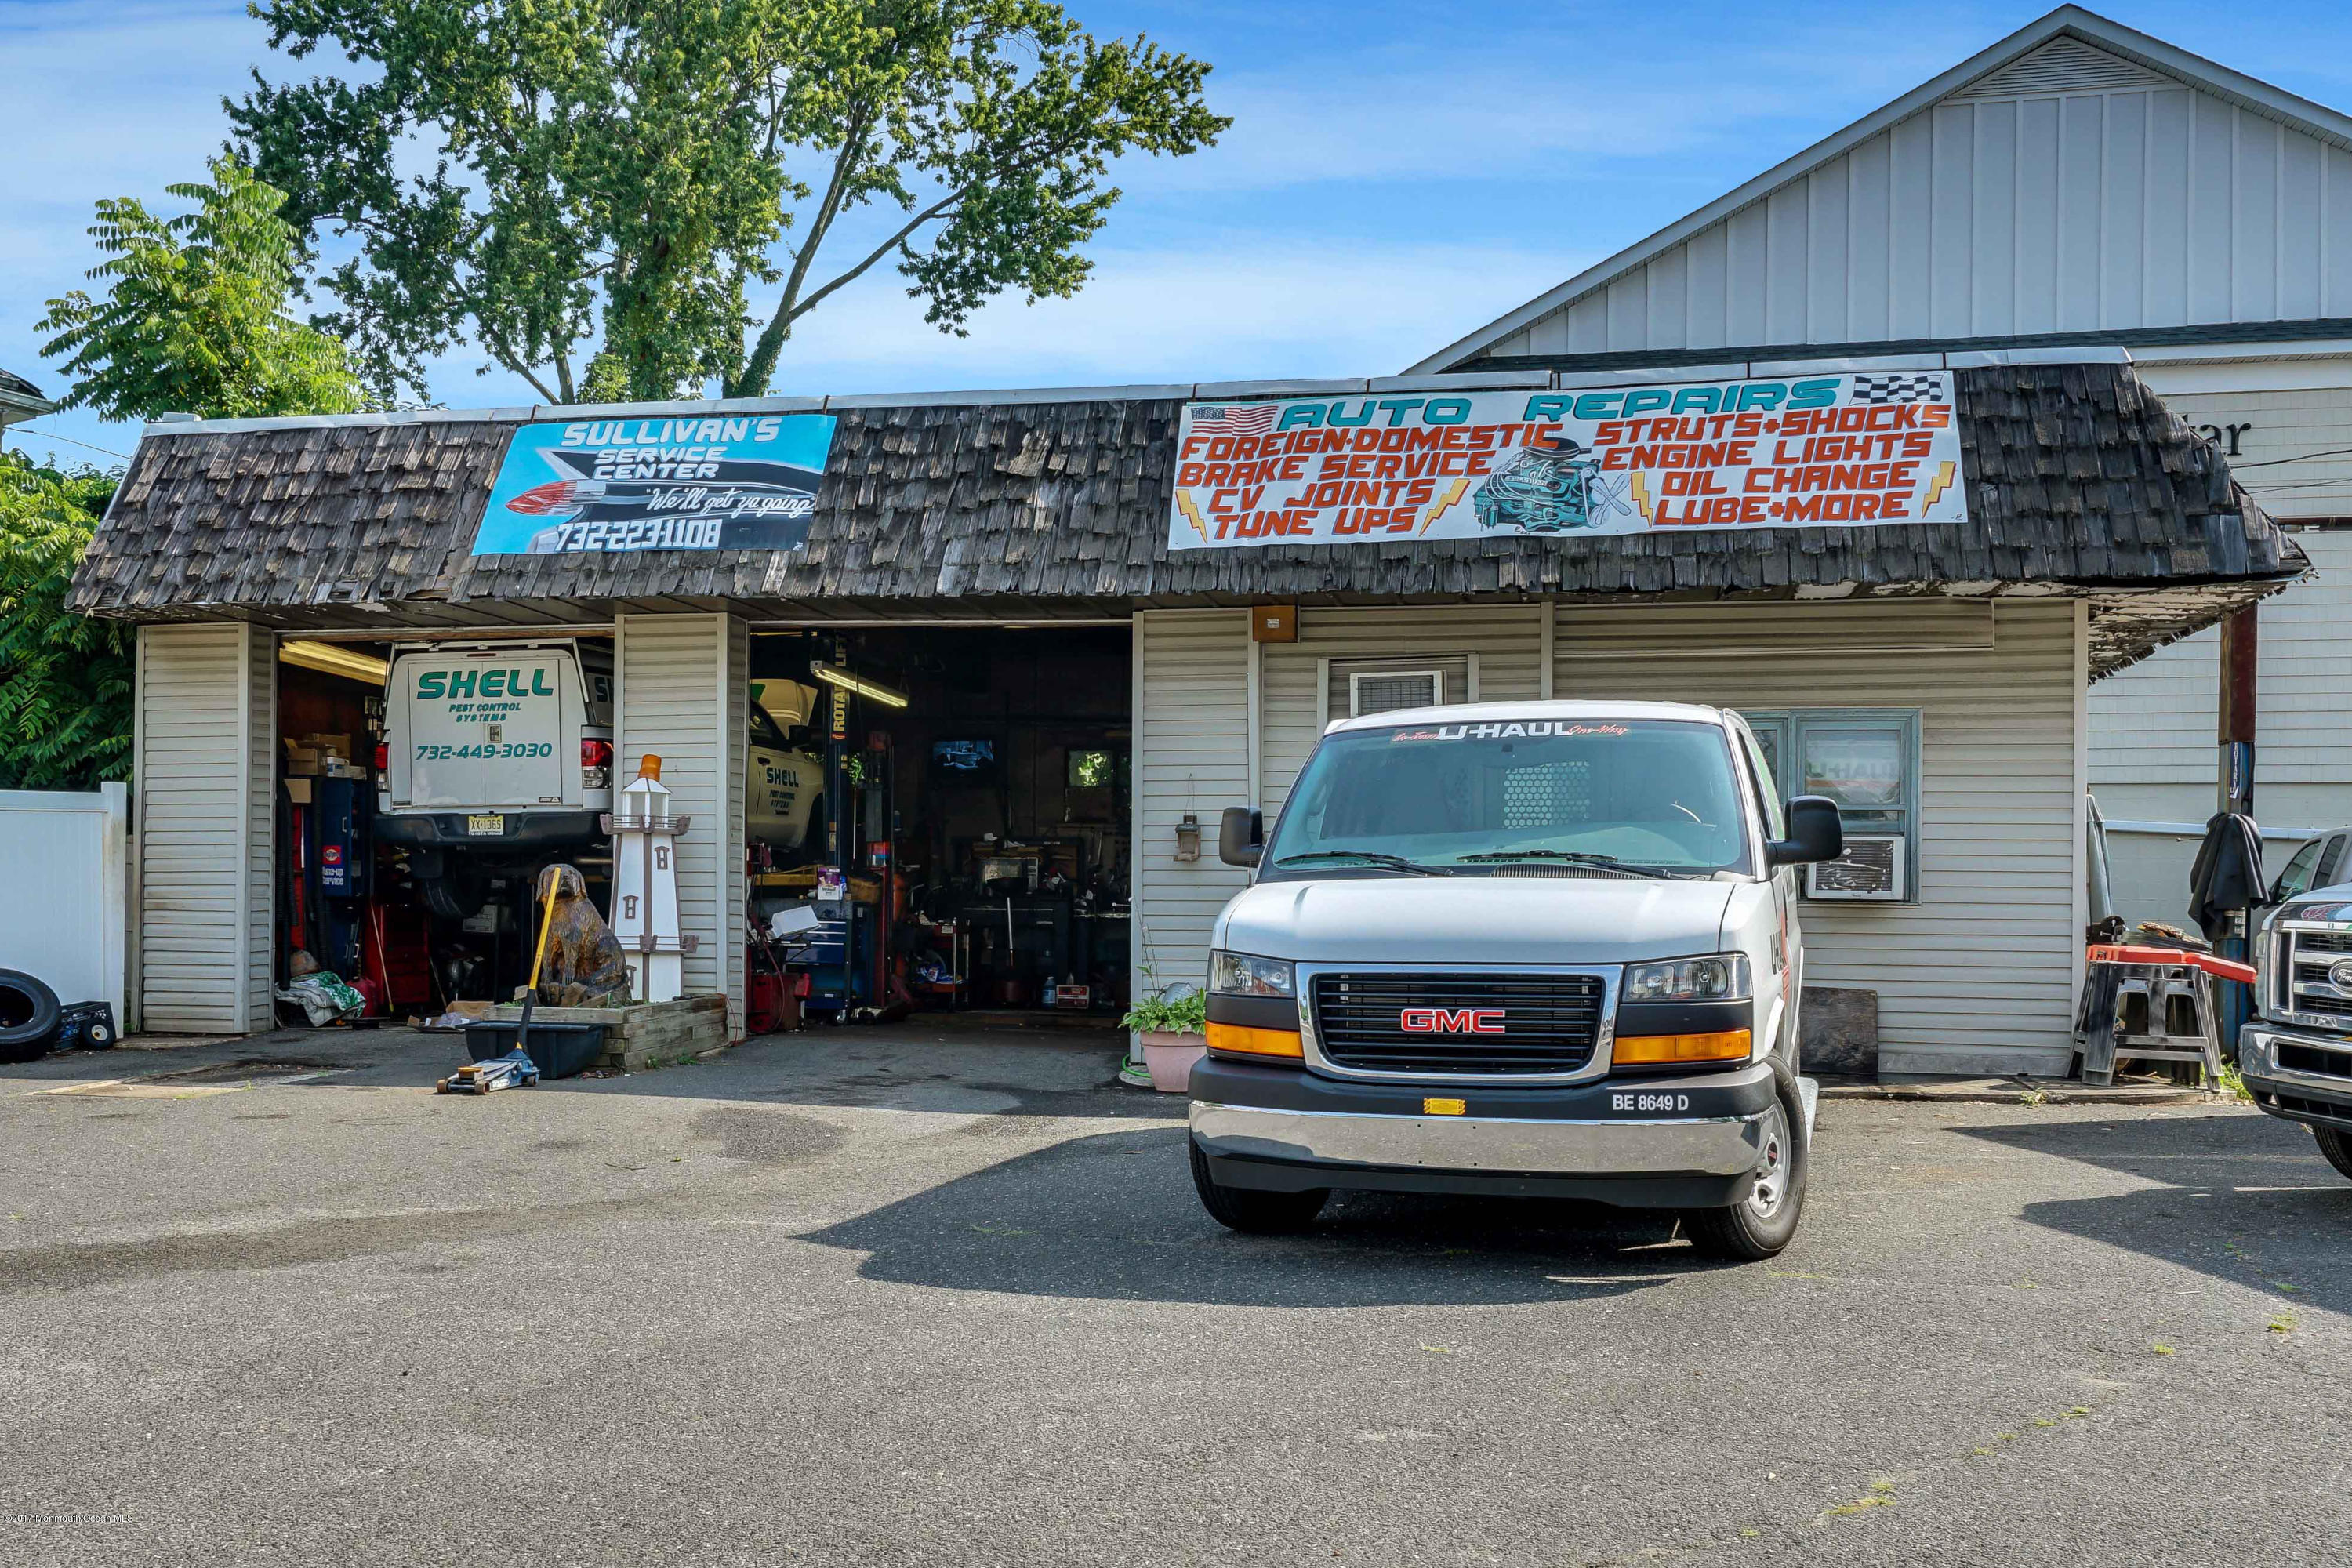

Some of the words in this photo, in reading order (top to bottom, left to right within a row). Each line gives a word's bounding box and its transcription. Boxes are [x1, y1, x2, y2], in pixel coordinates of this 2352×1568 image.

[1277, 398, 1472, 430] AUTO
[1523, 379, 1842, 422] REPAIRS
[561, 418, 782, 447] SULLIVAN'S
[2183, 414, 2252, 456] ar
[594, 447, 728, 464] SERVICE
[1601, 440, 1758, 471] ENGINE
[1771, 431, 1934, 466] LIGHTS
[593, 463, 720, 480] CENTER
[1177, 455, 1309, 488] BRAKE
[1317, 450, 1497, 483] SERVICE
[1661, 470, 1728, 496] OIL
[1741, 460, 1920, 494] CHANGE
[699, 487, 743, 515] get
[731, 496, 759, 518] ya
[1207, 484, 1265, 514] CV
[1284, 477, 1436, 509] JOINTS
[556, 519, 723, 551] 732-223-1108
[1214, 509, 1319, 540] TUNE
[1332, 506, 1419, 535] UPS
[416, 669, 554, 699] SHELL
[448, 703, 474, 712] PEST
[477, 702, 521, 712] CONTROL
[456, 713, 506, 722] SYSTEMS
[1438, 722, 1573, 740] U-HAUL
[415, 743, 553, 761] 732-449-3030
[767, 767, 799, 788] SHELL
[1401, 1008, 1506, 1034] GMC
[1613, 1094, 1635, 1110] BE
[1638, 1094, 1673, 1110] 8649
[1678, 1094, 1689, 1110] D
